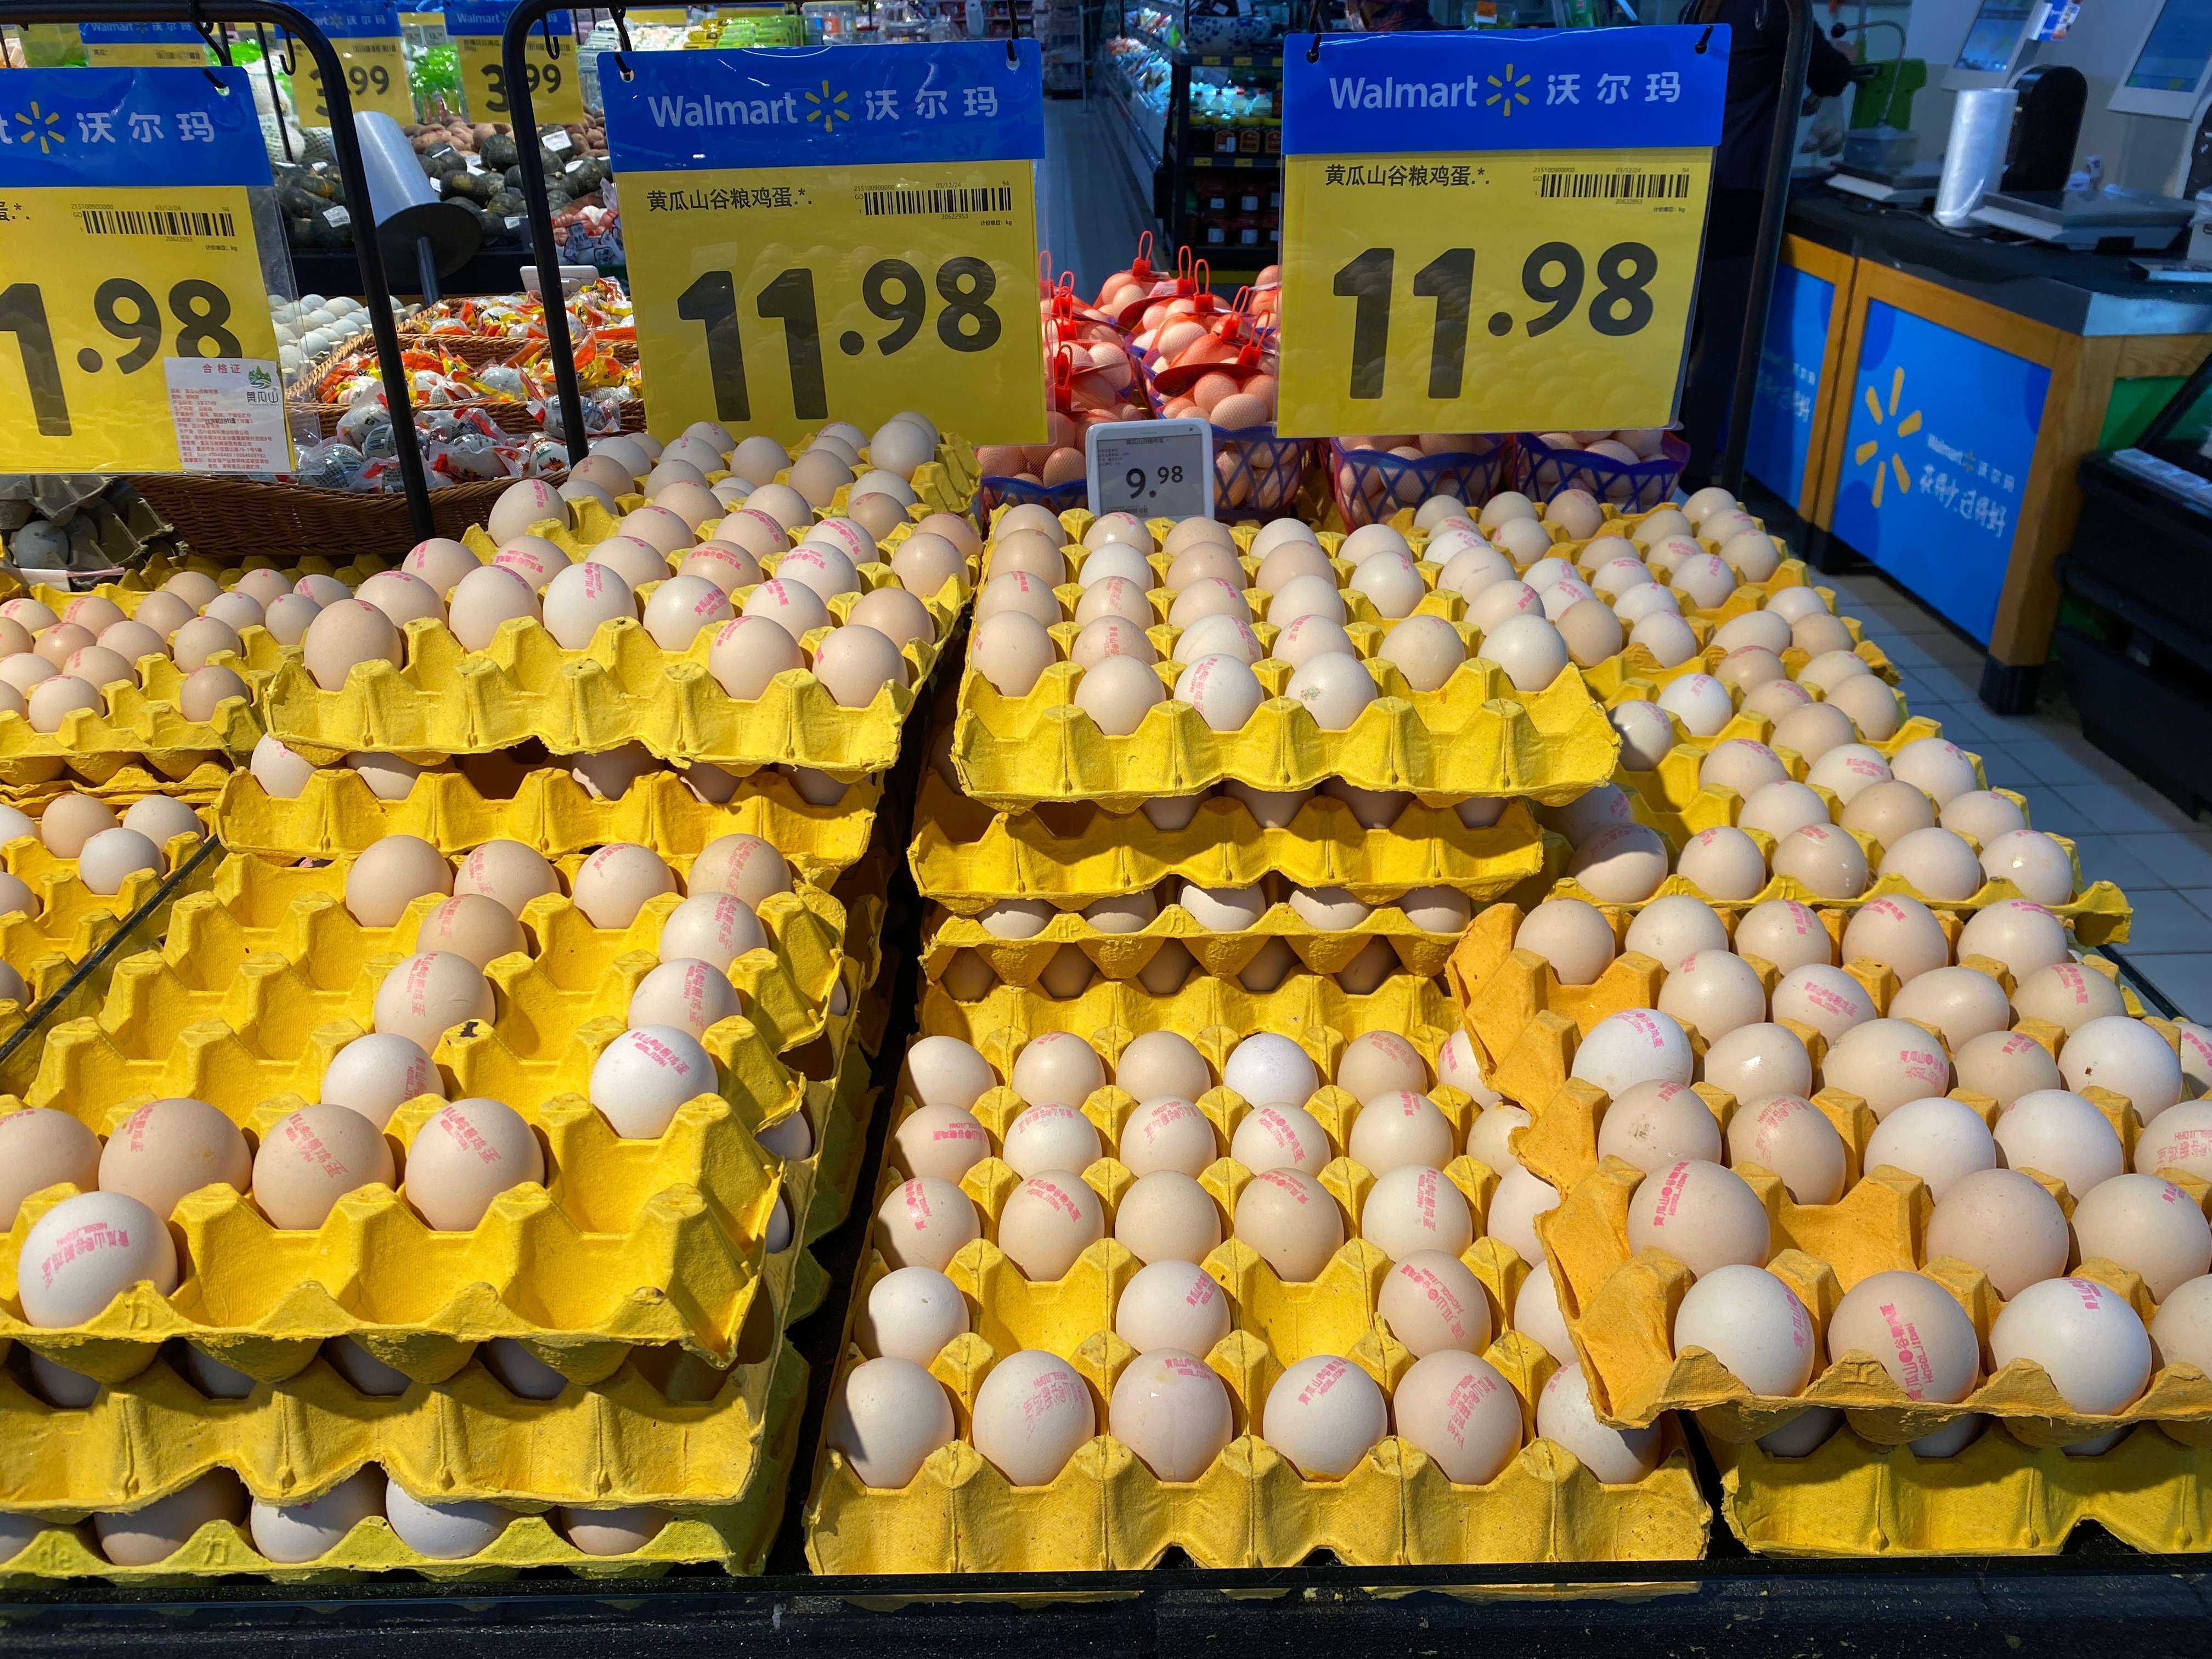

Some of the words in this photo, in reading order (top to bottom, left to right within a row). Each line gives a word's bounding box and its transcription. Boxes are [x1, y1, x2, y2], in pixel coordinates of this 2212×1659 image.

[456, 13, 500, 23] Walmart
[648, 92, 798, 128] Walmart
[865, 86, 998, 122] 沃尔玛
[1329, 75, 1477, 110] Walmart
[1547, 71, 1681, 106] 沃尔玛
[78, 111, 215, 144] 沃尔玛
[1333, 241, 1658, 400] 11.98
[677, 256, 1002, 422] 11.98
[202, 363, 241, 374] 合格证
[1126, 465, 1183, 499] 9.98
